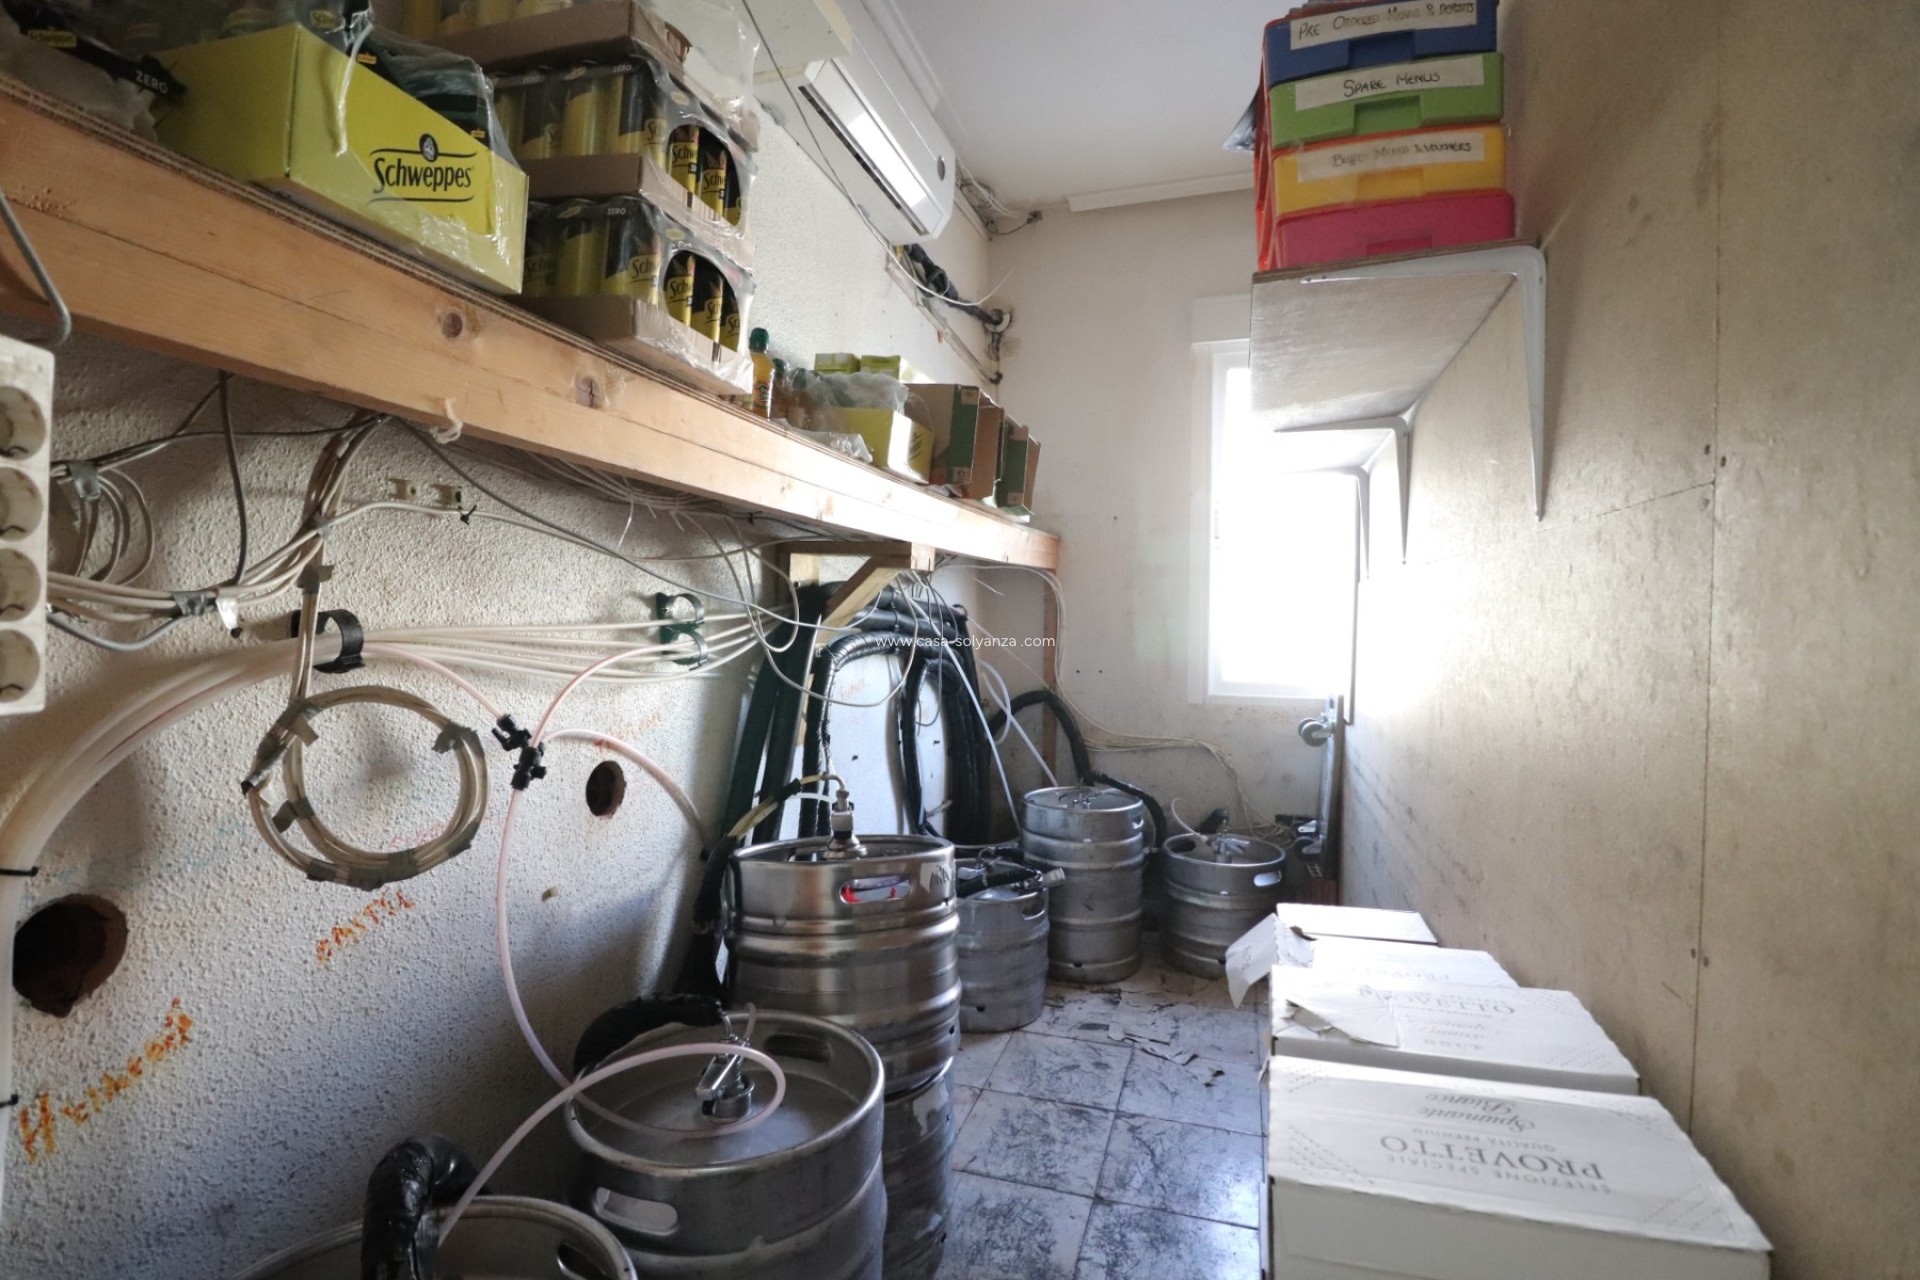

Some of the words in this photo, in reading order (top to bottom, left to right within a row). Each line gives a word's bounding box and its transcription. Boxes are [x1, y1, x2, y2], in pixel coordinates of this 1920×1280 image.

[1298, 21, 1321, 40] PRE
[1426, 4, 1435, 17] &
[613, 64, 633, 72] ZERO
[136, 69, 168, 94] ZERO
[1343, 78, 1386, 97] SPARE
[1396, 71, 1441, 86] MENUS
[372, 157, 472, 194] Schweppes
[607, 207, 626, 215] ZERO
[1425, 1093, 1516, 1116] Bianco
[1418, 1106, 1535, 1134] Spumante
[1411, 1127, 1481, 1145] PREMIUM
[1385, 1155, 1480, 1175] SPECIALE
[1491, 1169, 1613, 1194] SELEZIONE
